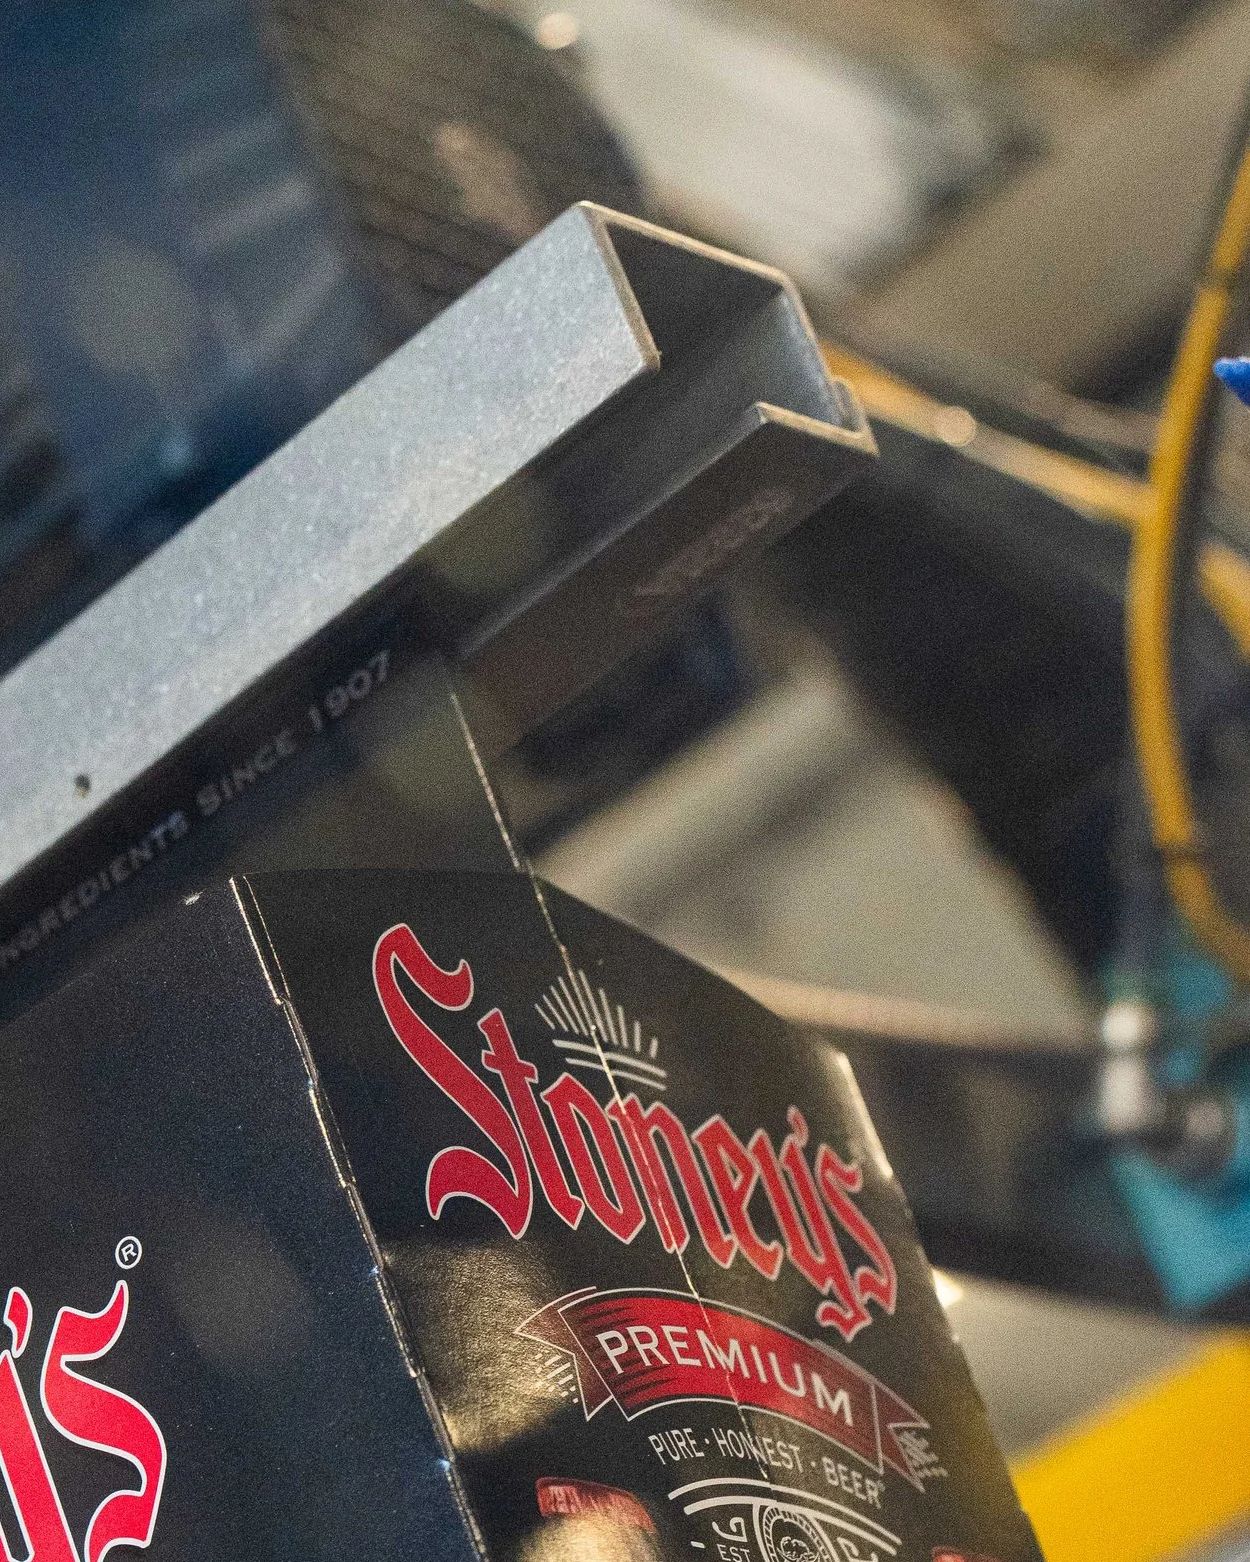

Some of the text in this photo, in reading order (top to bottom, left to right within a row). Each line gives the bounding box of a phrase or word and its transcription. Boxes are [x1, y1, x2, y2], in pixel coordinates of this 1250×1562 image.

[196, 730, 299, 817] SINCE
[307, 650, 390, 732] 1907
[372, 922, 898, 1342] Stoney's
[595, 1325, 854, 1426] PREMIUM
[648, 1427, 705, 1465] PURE
[711, 1427, 804, 1474] HONEST
